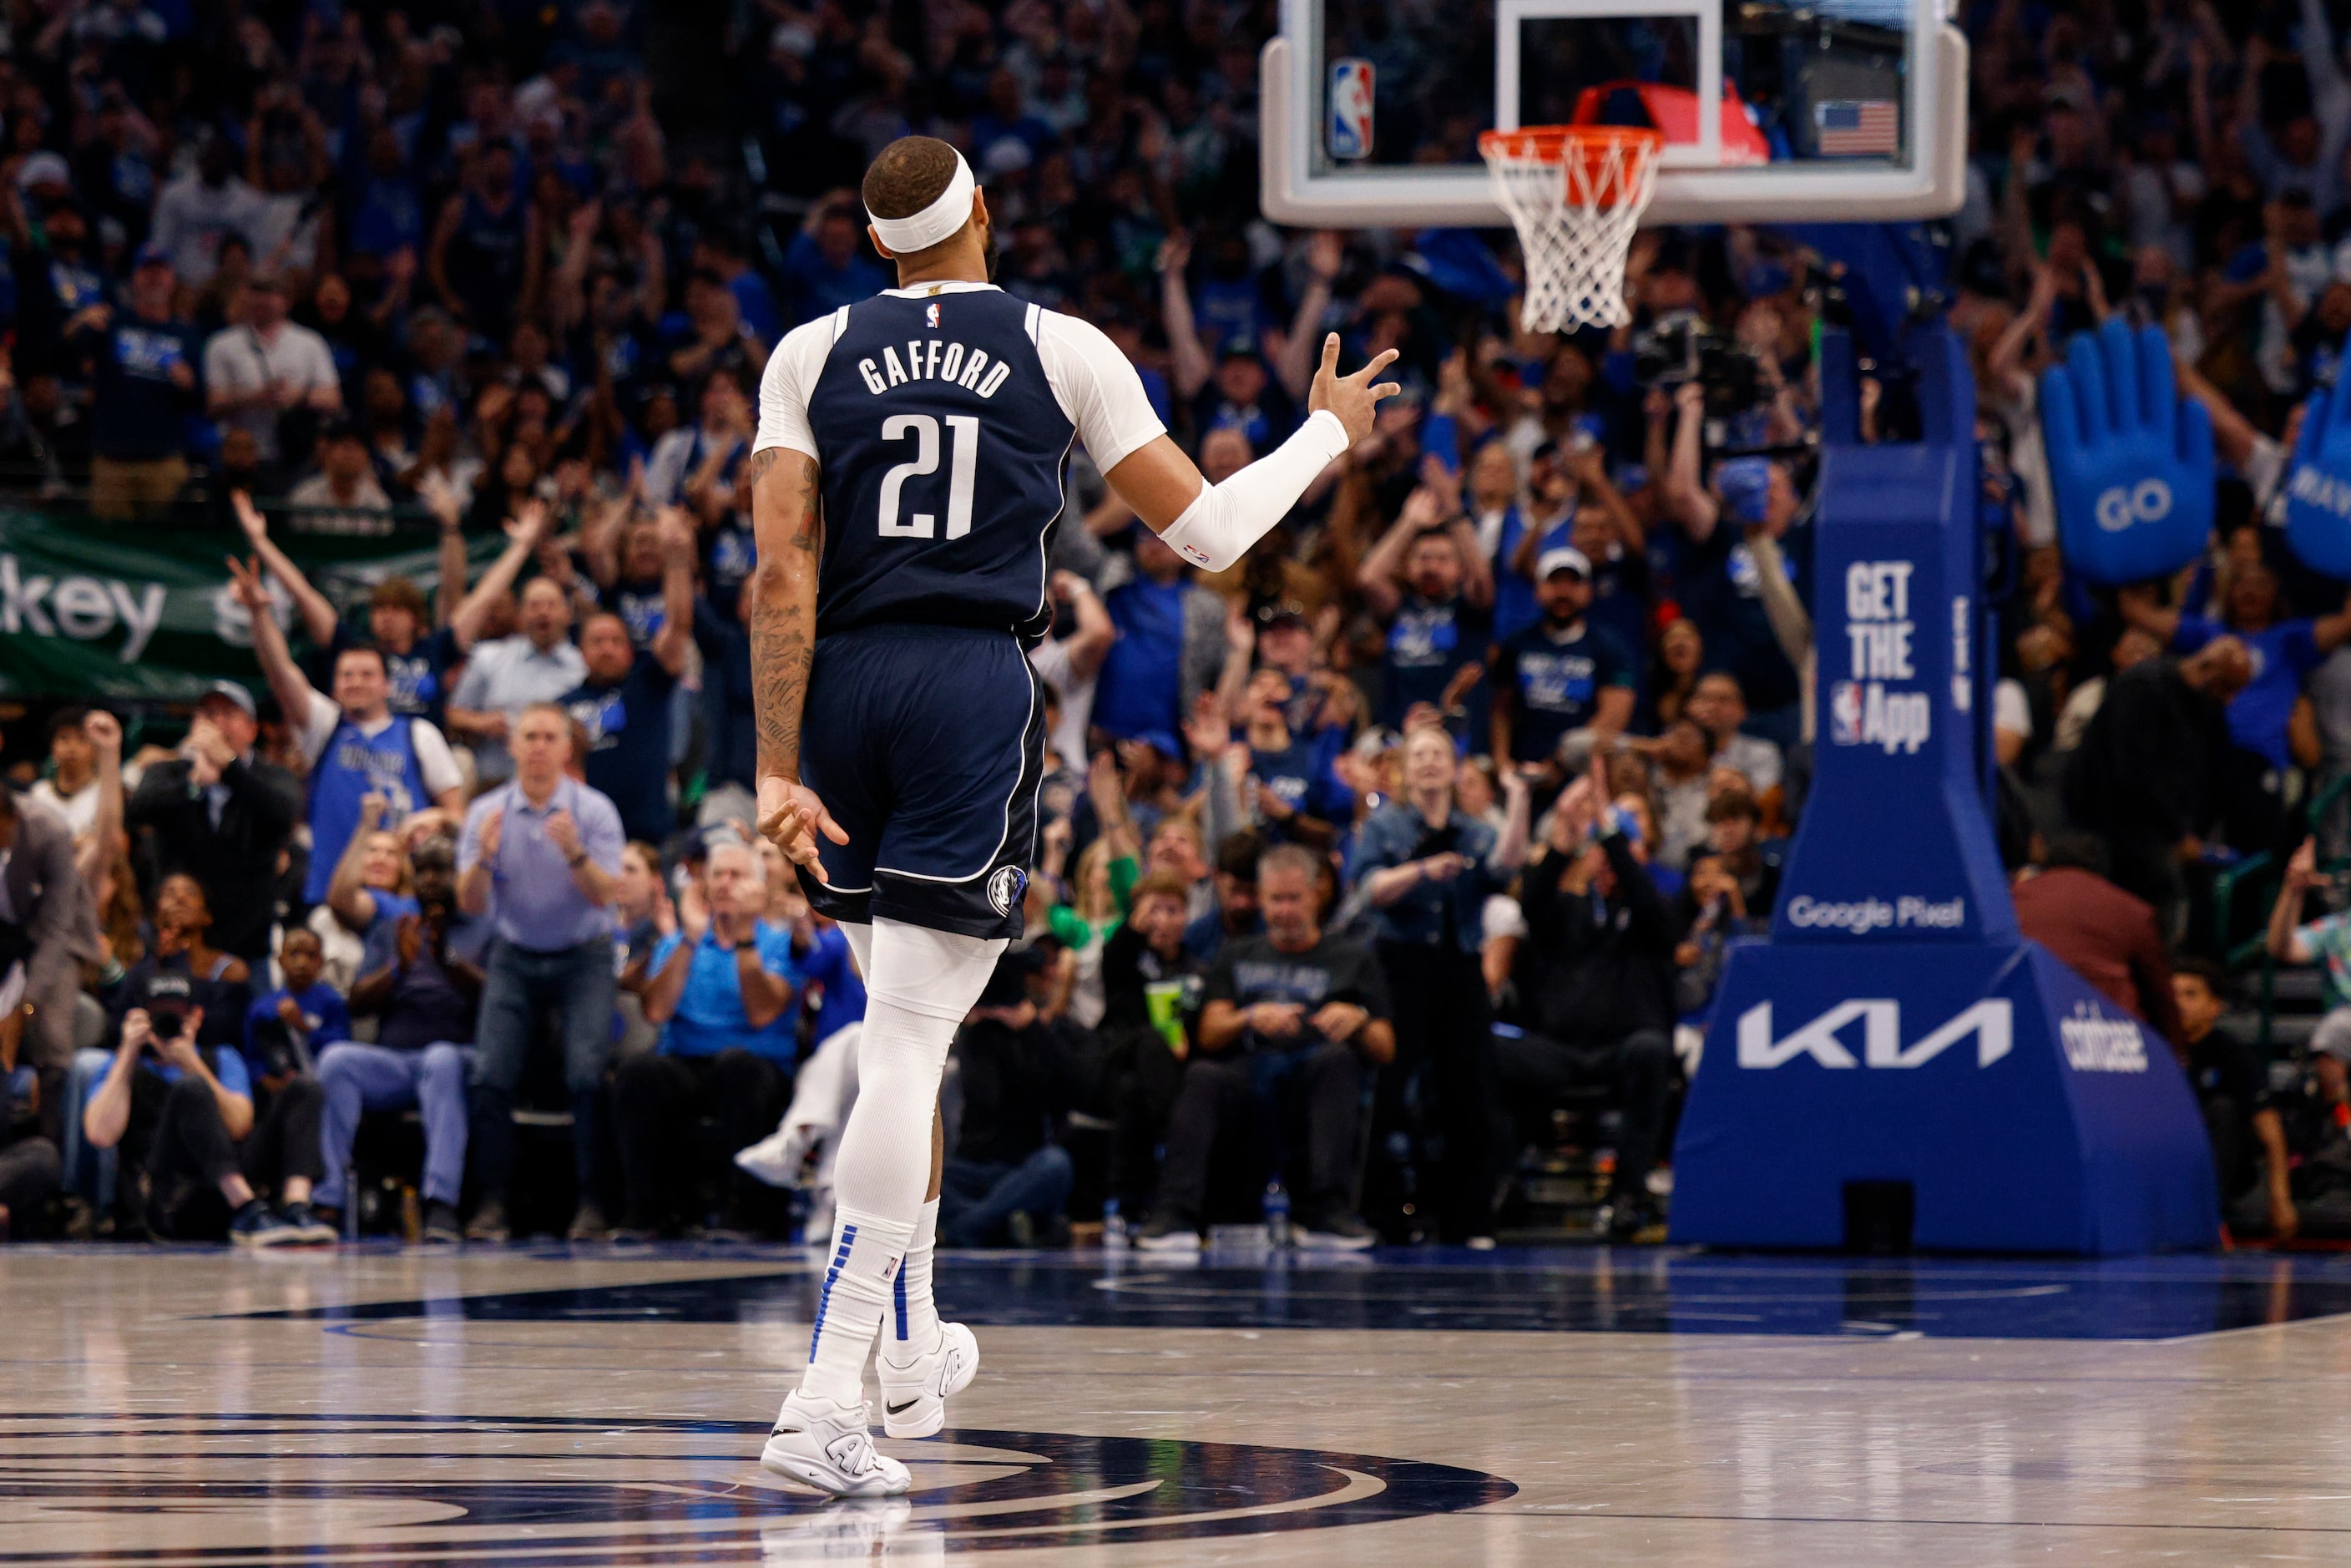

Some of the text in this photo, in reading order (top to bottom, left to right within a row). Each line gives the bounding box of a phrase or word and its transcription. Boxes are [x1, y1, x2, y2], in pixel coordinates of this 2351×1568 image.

[858, 340, 1011, 399] GAFFORD
[878, 414, 979, 541] 21
[2095, 477, 2172, 533] GO
[1846, 559, 1914, 620] GET
[1846, 620, 1915, 680] THE
[1862, 681, 1930, 755] App
[1787, 895, 1965, 935] Google Pixel
[1737, 998, 2014, 1070] KIA
